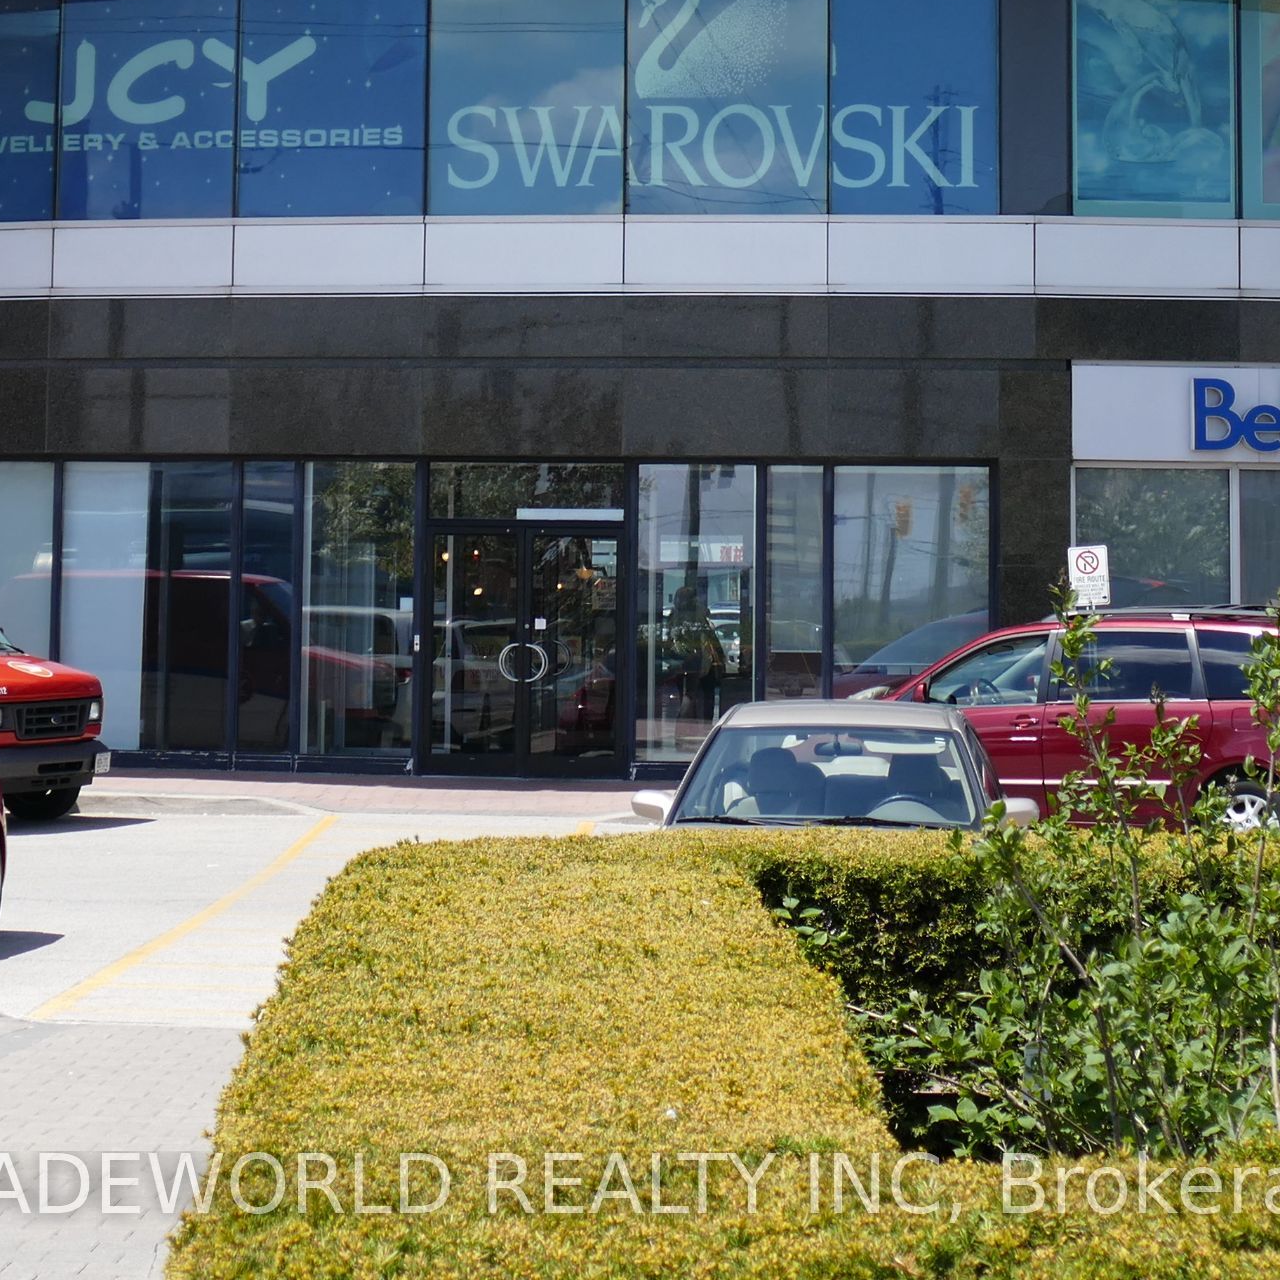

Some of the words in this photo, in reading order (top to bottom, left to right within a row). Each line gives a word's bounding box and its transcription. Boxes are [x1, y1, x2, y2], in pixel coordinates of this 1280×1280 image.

[24, 35, 317, 126] JCY
[137, 131, 159, 151] &
[170, 126, 404, 150] ACCESSORIES
[446, 103, 979, 190] SWAROVSKI
